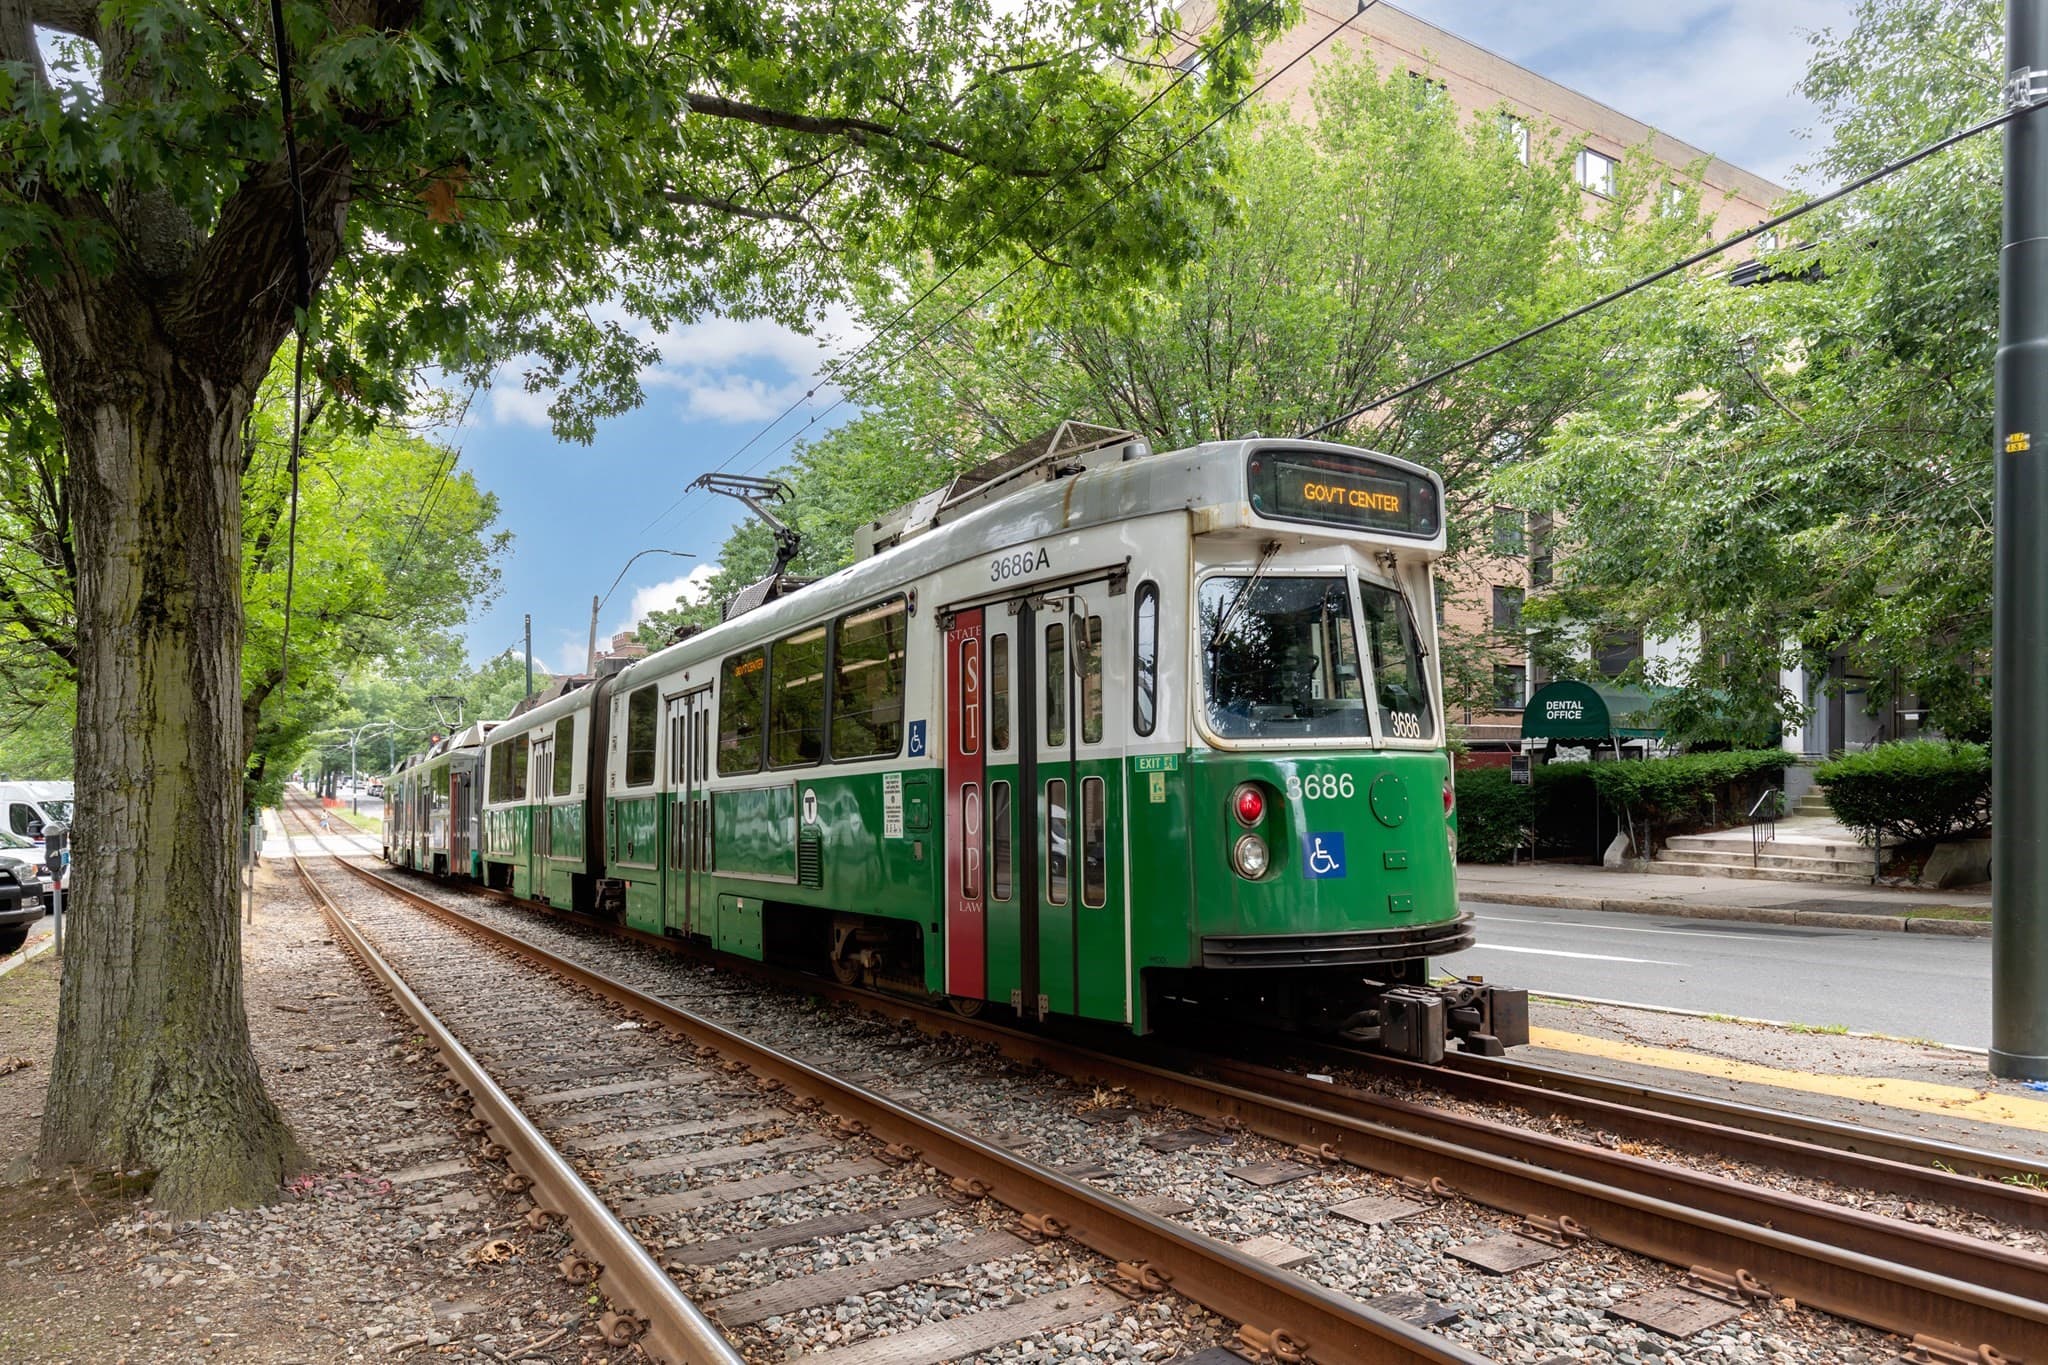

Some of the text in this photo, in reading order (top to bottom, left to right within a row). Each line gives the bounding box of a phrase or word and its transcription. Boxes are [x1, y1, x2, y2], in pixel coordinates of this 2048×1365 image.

[1304, 483, 1399, 512] GOV'T CENTER
[991, 547, 1050, 582] 3686A
[950, 625, 981, 641] STATE
[1546, 700, 1584, 710] DENTAL
[1391, 711, 1420, 738] 3686
[1546, 710, 1582, 720] OFFICE
[1140, 757, 1160, 769] EXIT
[1286, 773, 1355, 801] 3686
[805, 797, 814, 820] T
[959, 901, 982, 912] LAW
